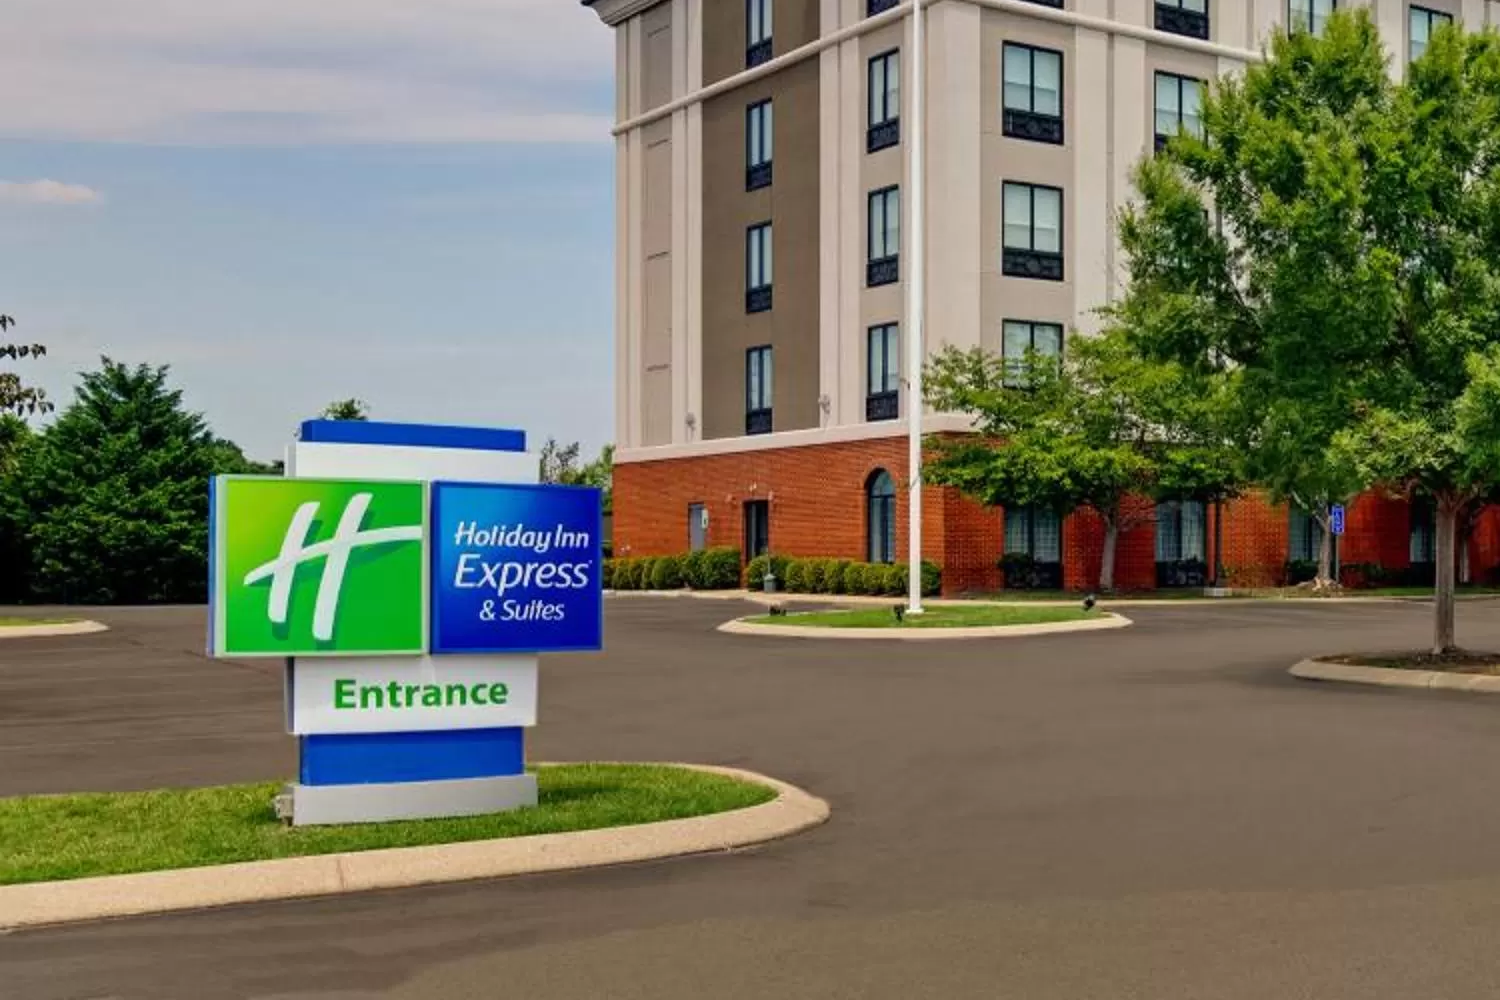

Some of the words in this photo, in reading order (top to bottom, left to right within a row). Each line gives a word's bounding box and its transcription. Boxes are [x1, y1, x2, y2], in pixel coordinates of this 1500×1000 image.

[453, 521, 551, 554] Holiday
[555, 525, 590, 549] Inn
[243, 492, 423, 641] H
[453, 554, 590, 596] Express
[479, 601, 496, 621] &
[500, 600, 566, 621] Suites
[334, 679, 509, 709] Entrance
